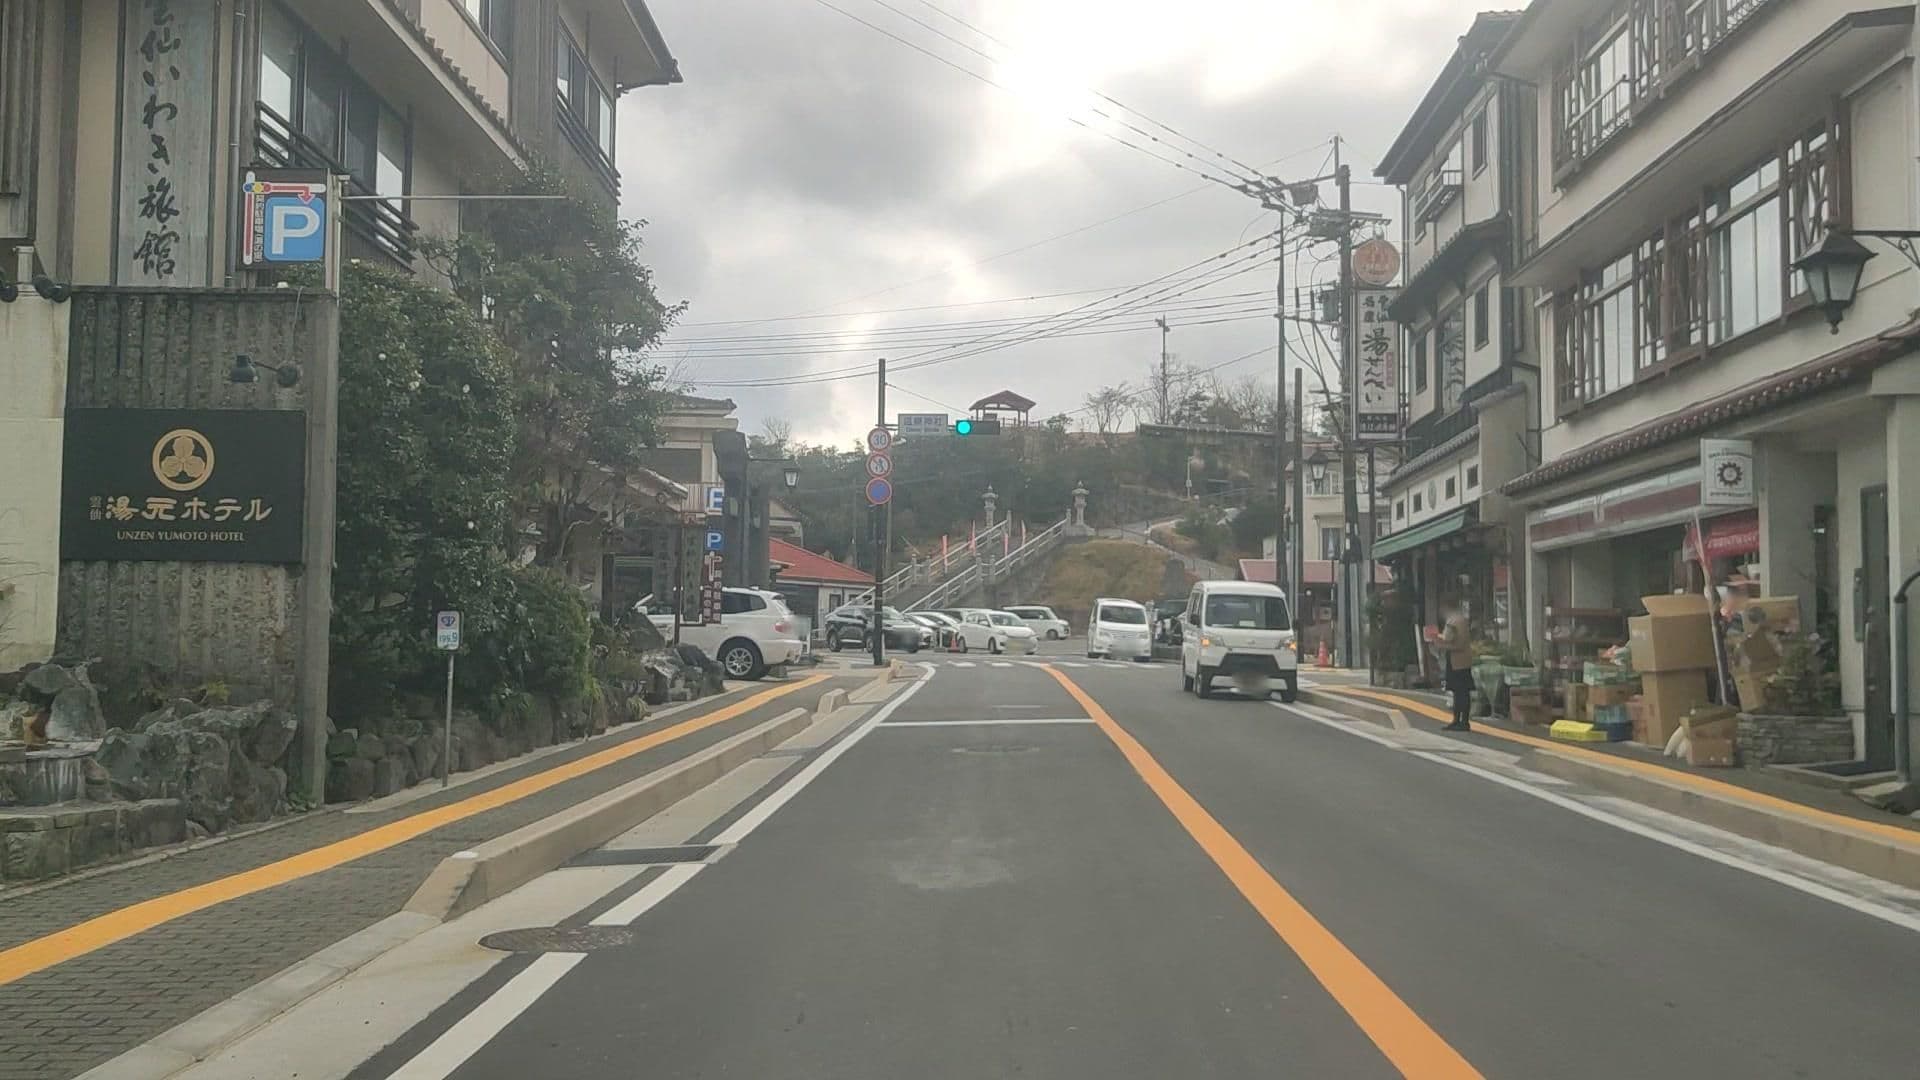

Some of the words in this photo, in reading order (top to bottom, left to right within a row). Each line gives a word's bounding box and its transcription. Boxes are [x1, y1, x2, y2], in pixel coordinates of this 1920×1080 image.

[272, 206, 320, 254] P
[873, 434, 887, 446] 30
[105, 496, 273, 521] 湯元ホテル
[117, 531, 154, 541] UNZEN
[158, 531, 207, 541] YUMOTO
[210, 531, 244, 541] HOTEL
[707, 532, 722, 547] P
